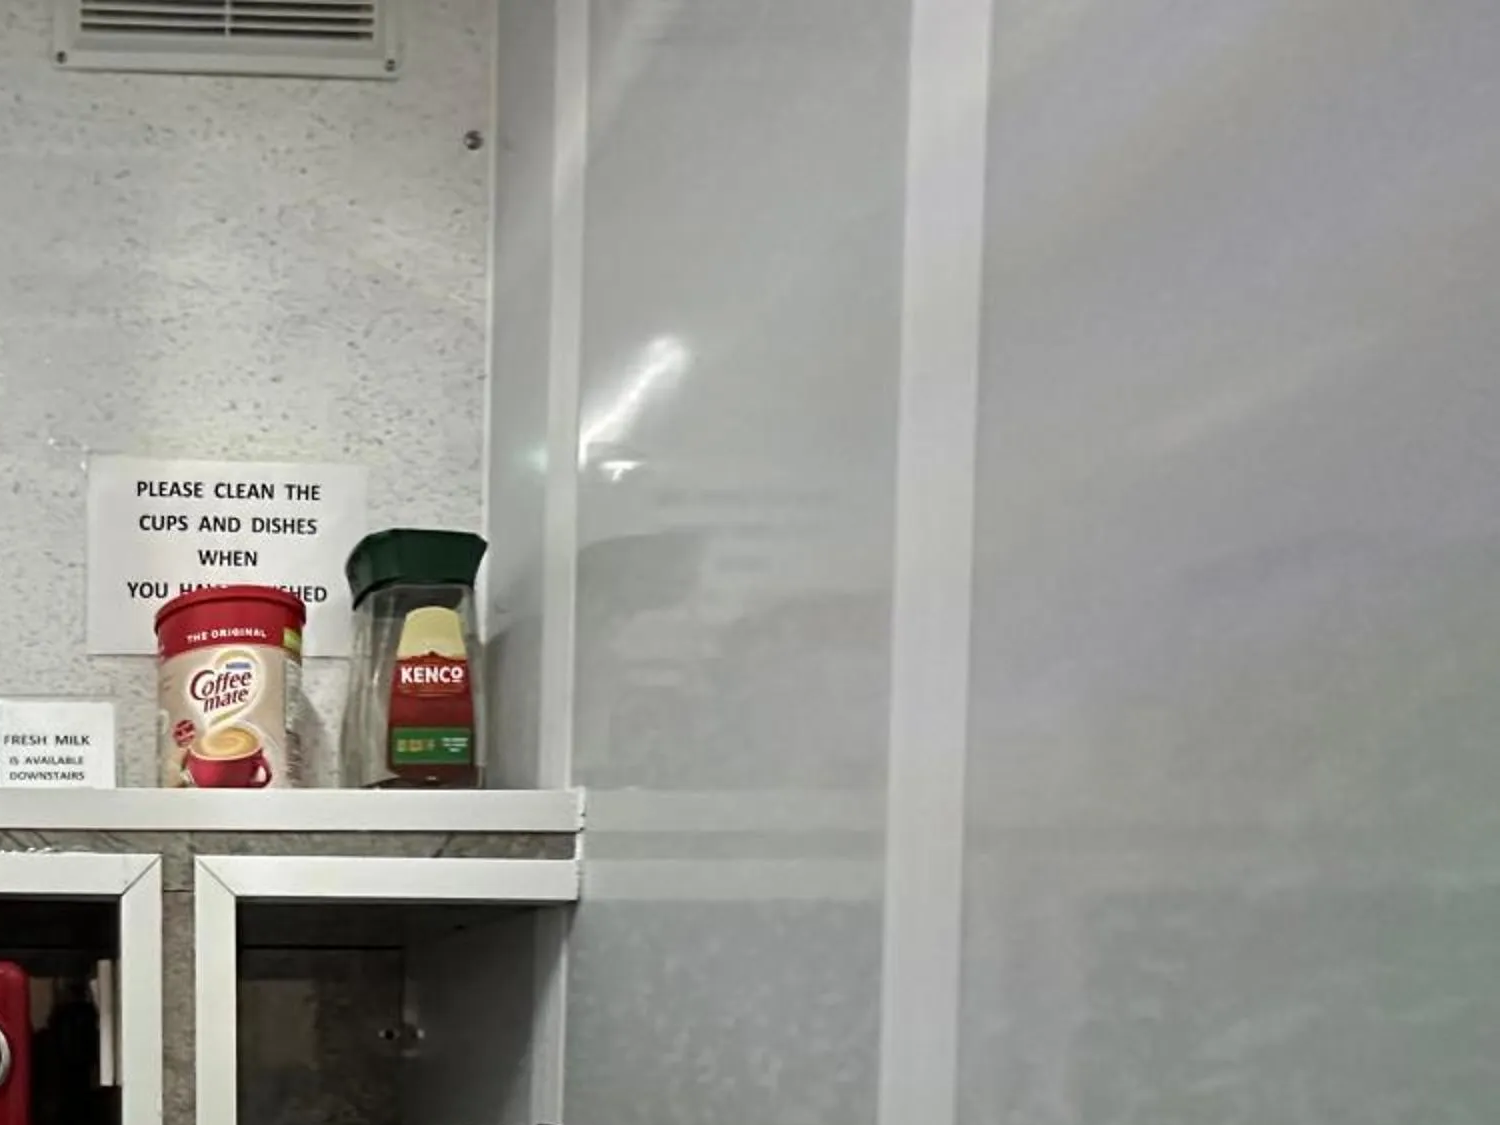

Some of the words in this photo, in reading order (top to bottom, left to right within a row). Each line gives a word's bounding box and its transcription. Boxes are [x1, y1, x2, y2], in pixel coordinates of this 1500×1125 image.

[136, 481, 204, 498] PLEASE
[214, 483, 275, 499] CLEAN
[285, 484, 321, 501] THE
[139, 515, 188, 532] CUPS
[198, 516, 241, 533] AND
[251, 518, 317, 535] DISHES
[198, 550, 258, 567] WHEN
[127, 582, 168, 599] YOU
[187, 632, 208, 644] THE
[211, 627, 267, 639] ORIGINAL
[400, 666, 464, 684] KENCO
[190, 669, 252, 701] Coffee
[203, 688, 249, 713] mate
[3, 735, 47, 746] FRESH
[55, 735, 91, 747] MILK
[25, 756, 84, 765] AVAILABLE
[9, 771, 85, 781] DOWNSTAIRS
